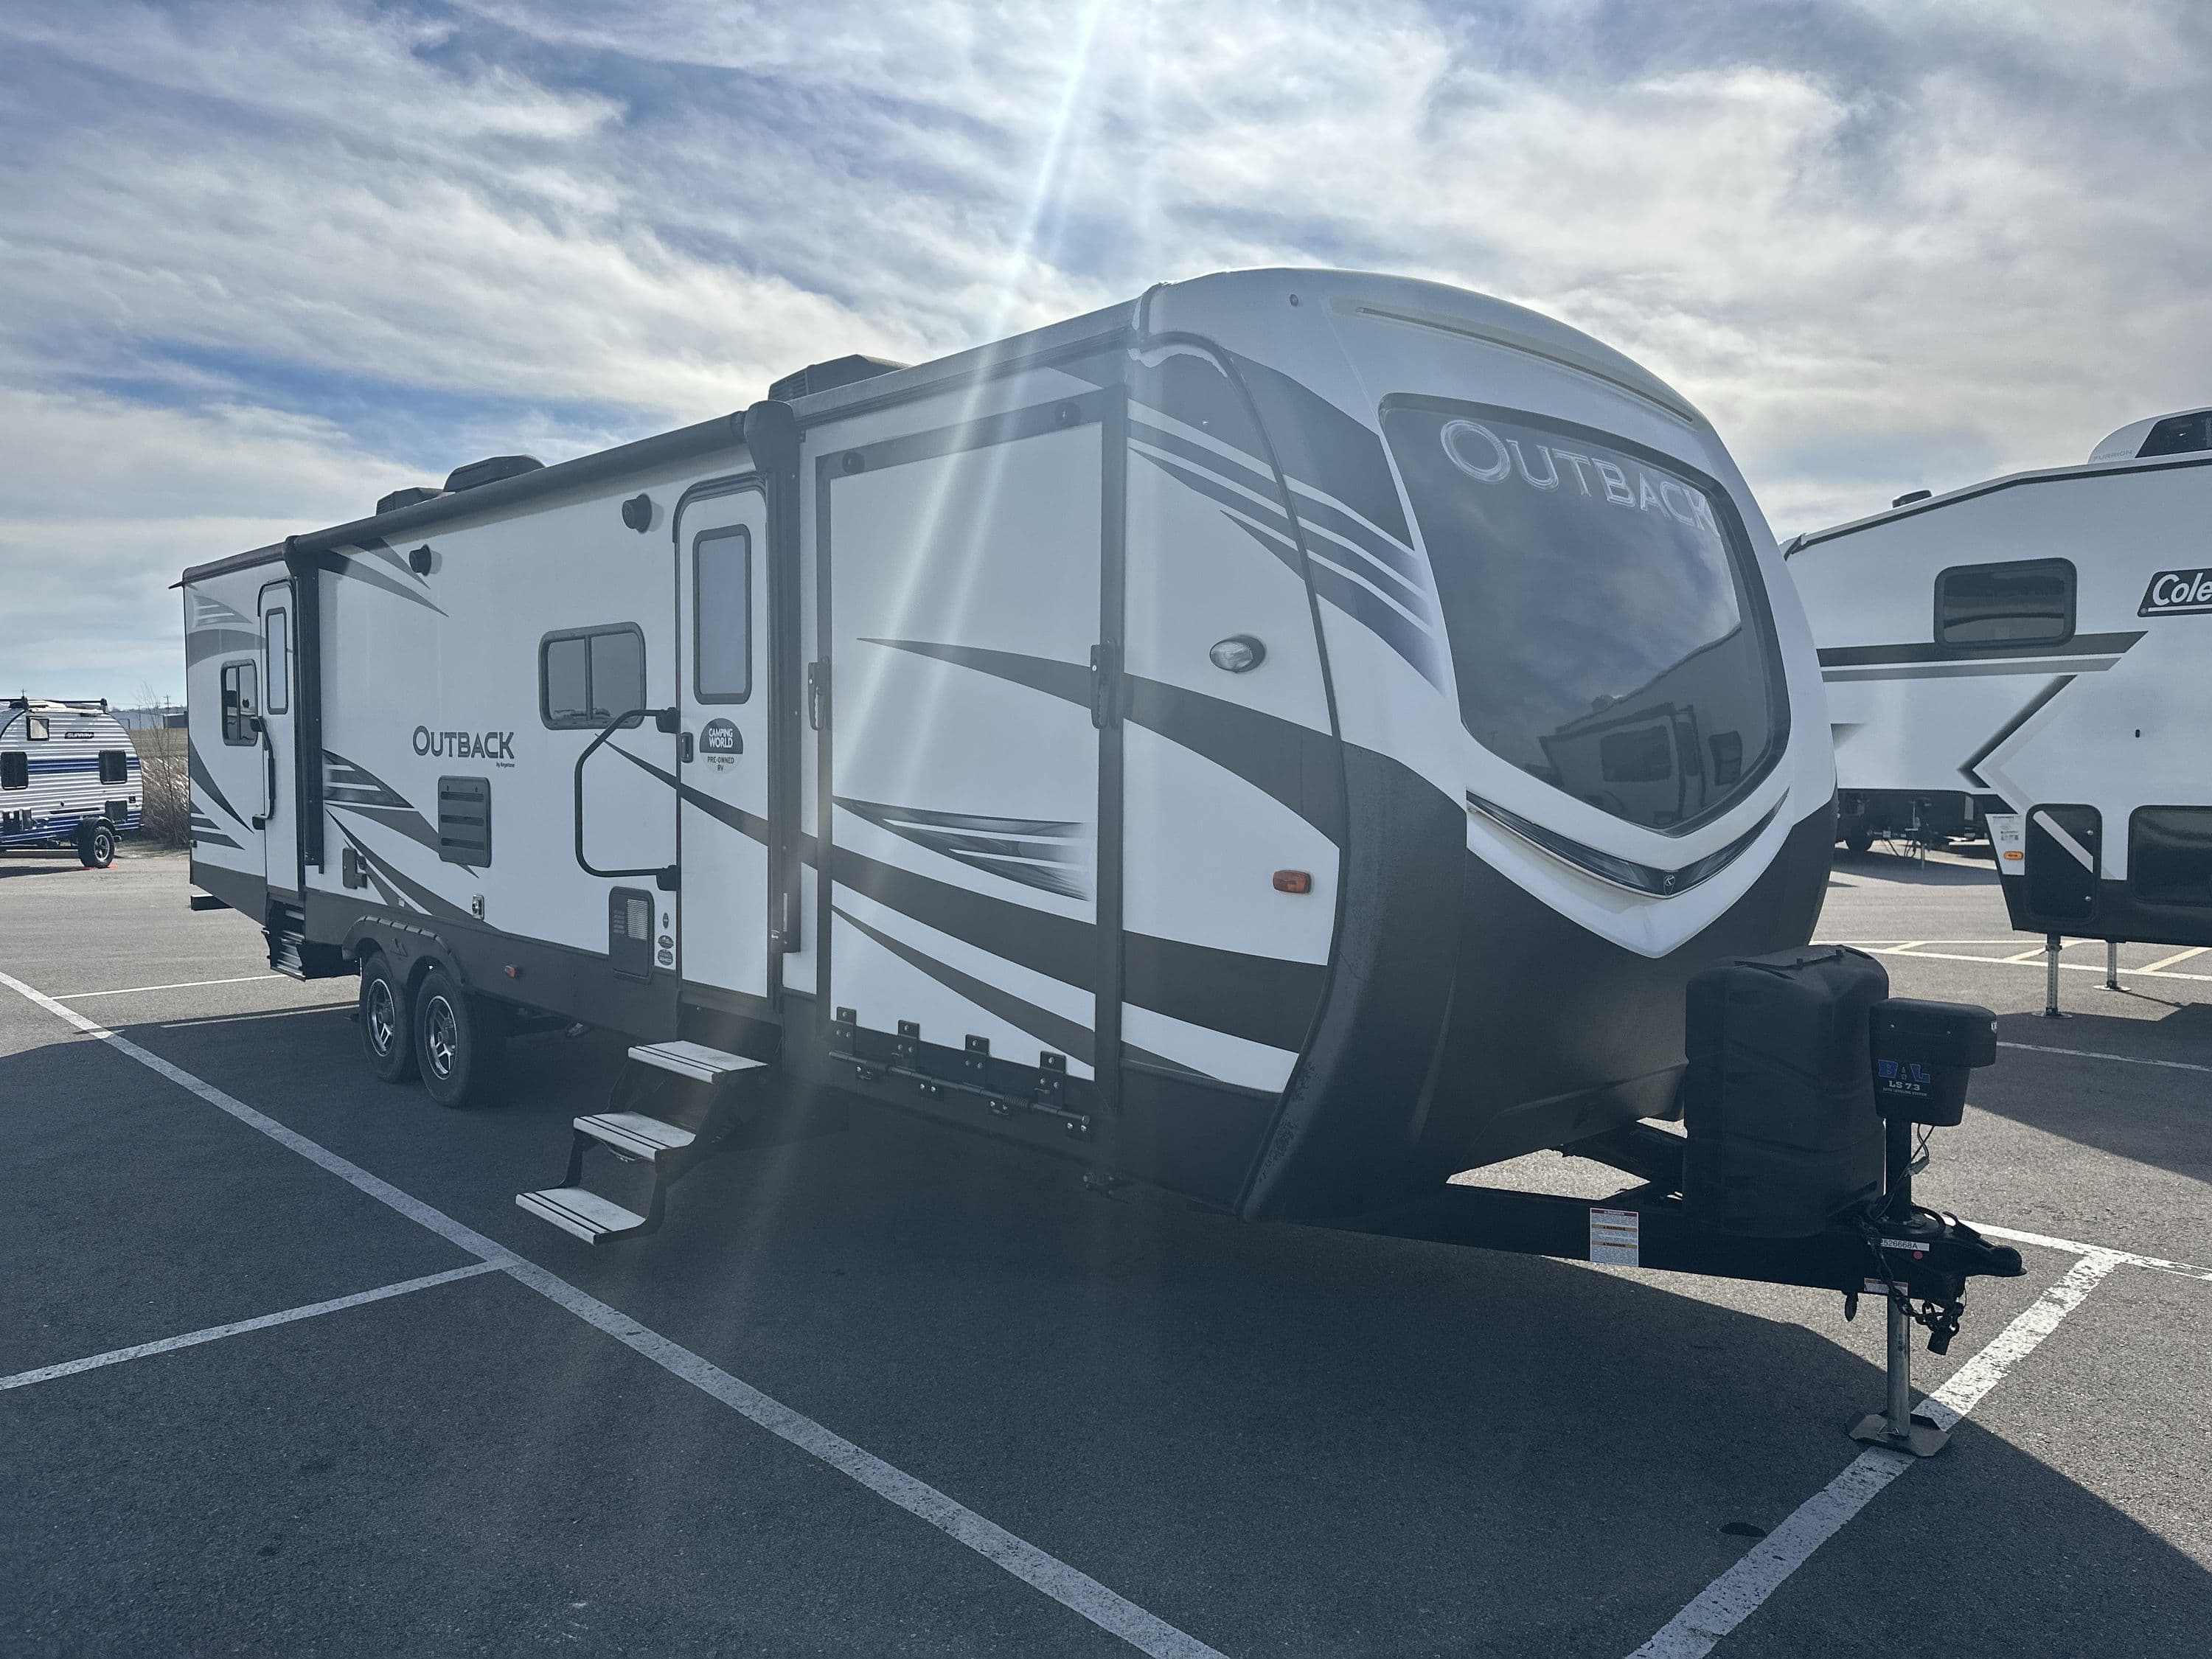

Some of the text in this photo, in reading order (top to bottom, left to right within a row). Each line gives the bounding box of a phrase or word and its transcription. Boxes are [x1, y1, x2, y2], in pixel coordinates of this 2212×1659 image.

[1440, 419, 1721, 540] OUTBACK
[2152, 571, 2212, 606] Cole
[709, 728, 733, 737] CAMPING
[412, 725, 515, 759] OUTBACK
[709, 737, 734, 748] WORLD
[707, 756, 734, 764] PRE-OWNED
[1888, 1080, 1920, 1091] LS 73
